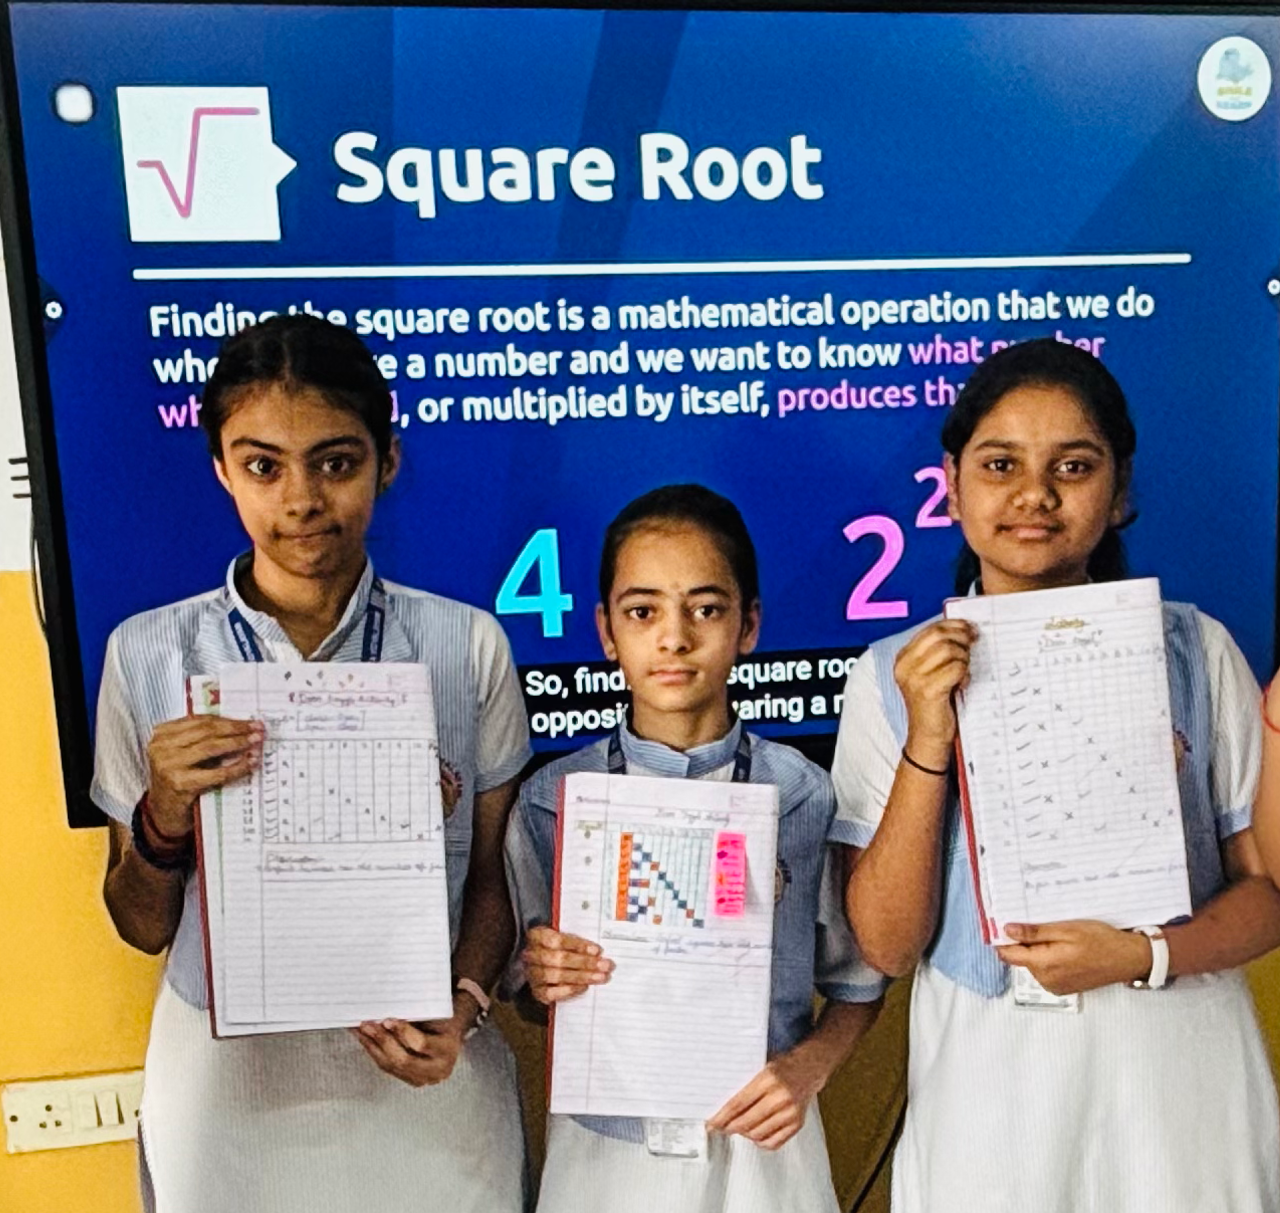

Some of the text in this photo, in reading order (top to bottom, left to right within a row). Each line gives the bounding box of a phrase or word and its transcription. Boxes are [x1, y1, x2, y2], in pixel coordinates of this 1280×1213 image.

[334, 131, 824, 219] Square Root
[149, 302, 280, 338] Findin
[355, 307, 470, 341] square
[478, 301, 552, 334] root
[557, 298, 585, 331] is
[591, 305, 612, 331] a
[618, 294, 836, 331] mathematical
[840, 291, 990, 331] operation
[997, 289, 1061, 321] that
[1066, 294, 1110, 319] we
[1116, 285, 1156, 318] do
[406, 354, 427, 379] a
[434, 342, 564, 378] number
[569, 340, 630, 376] and
[636, 346, 685, 373] we
[690, 340, 772, 372] want
[777, 340, 812, 370] to
[818, 335, 903, 370] know
[907, 333, 985, 366] what
[416, 396, 456, 424] or
[461, 384, 628, 427] multiplied
[634, 383, 675, 423] by
[680, 380, 770, 419] itself,
[777, 378, 919, 419] produces
[842, 466, 954, 621] 2 2
[494, 528, 573, 638] 4
[525, 670, 570, 700] So,
[810, 695, 828, 716] a
